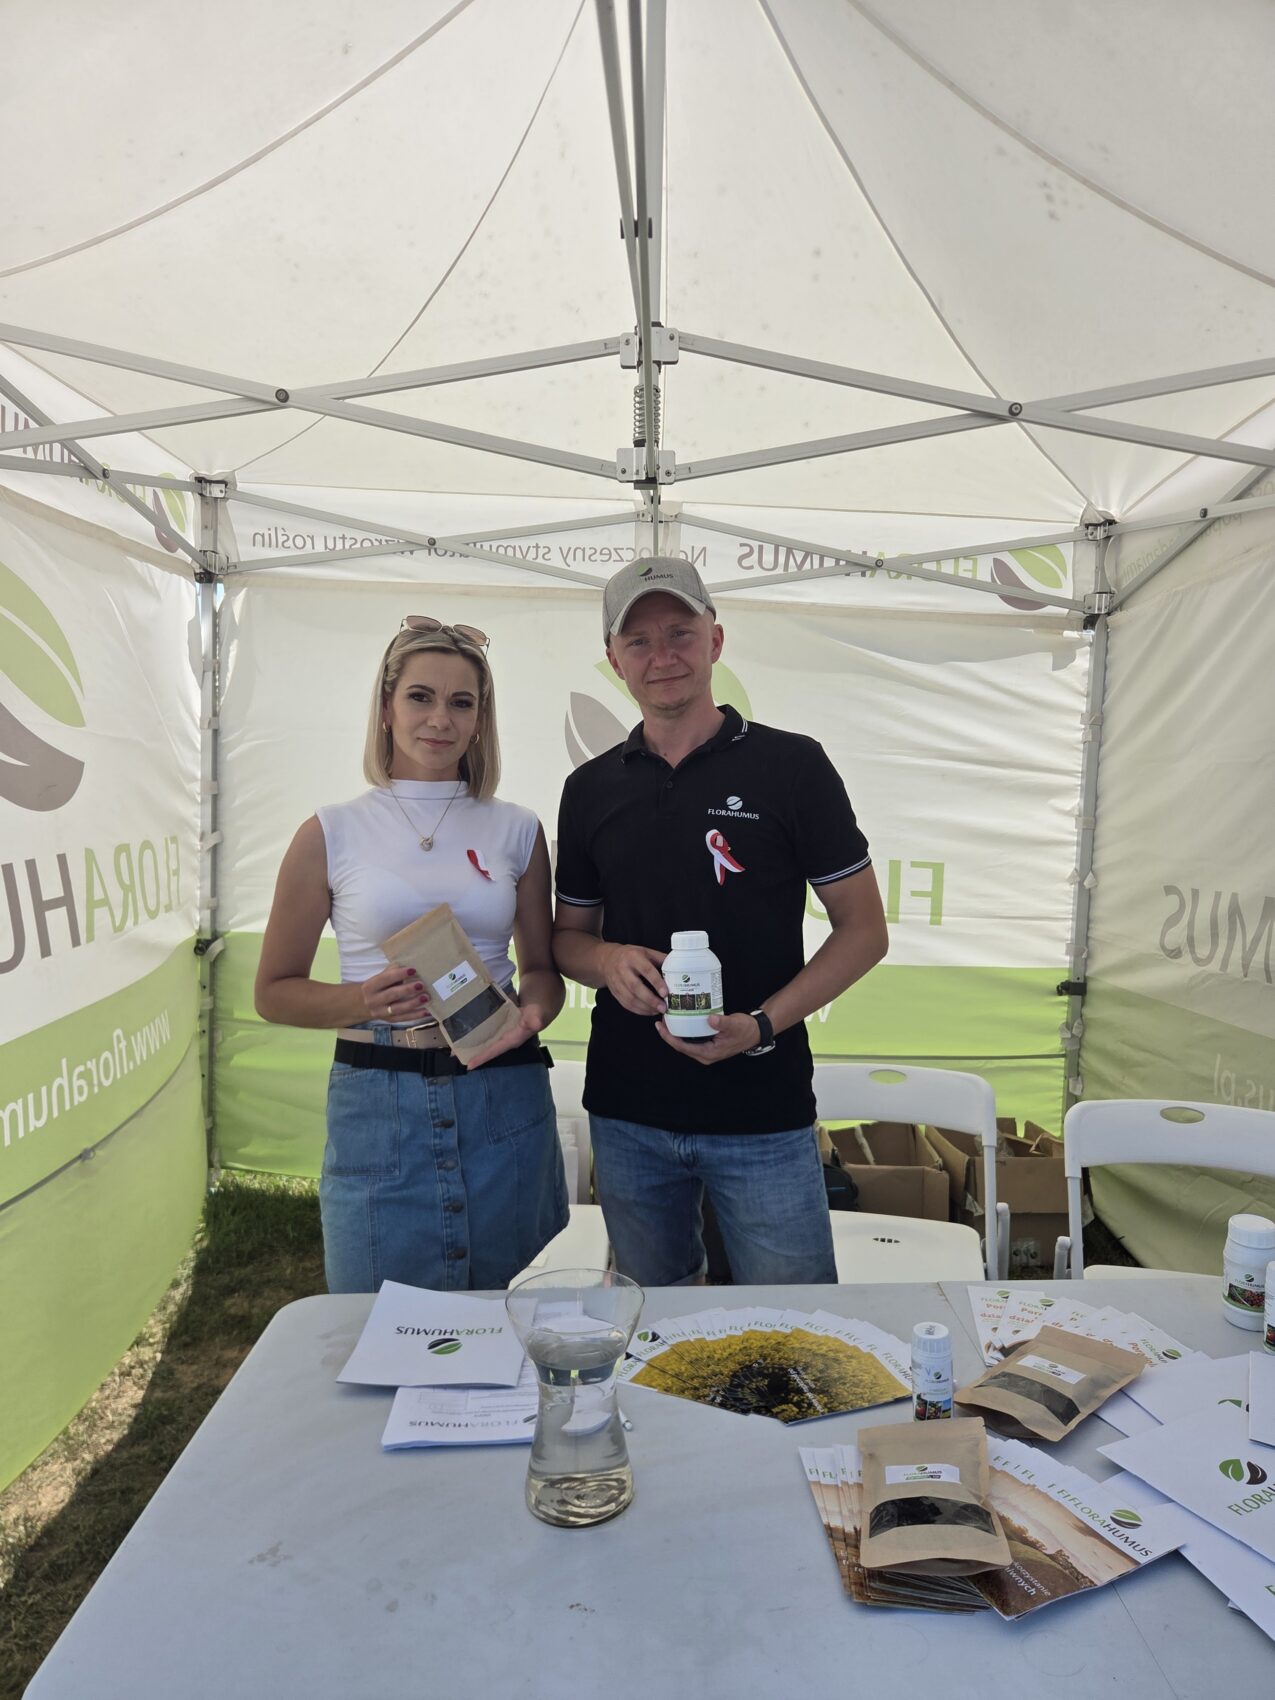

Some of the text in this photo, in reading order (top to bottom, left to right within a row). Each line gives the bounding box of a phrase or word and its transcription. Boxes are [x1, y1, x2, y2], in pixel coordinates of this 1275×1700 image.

[707, 808, 760, 820] FLORAHUMUS
[395, 1325, 503, 1336] FLORAHUMUS
[408, 1419, 518, 1428] FLORAHUMUS
[1068, 1498, 1153, 1558] FLORAHUMUS
